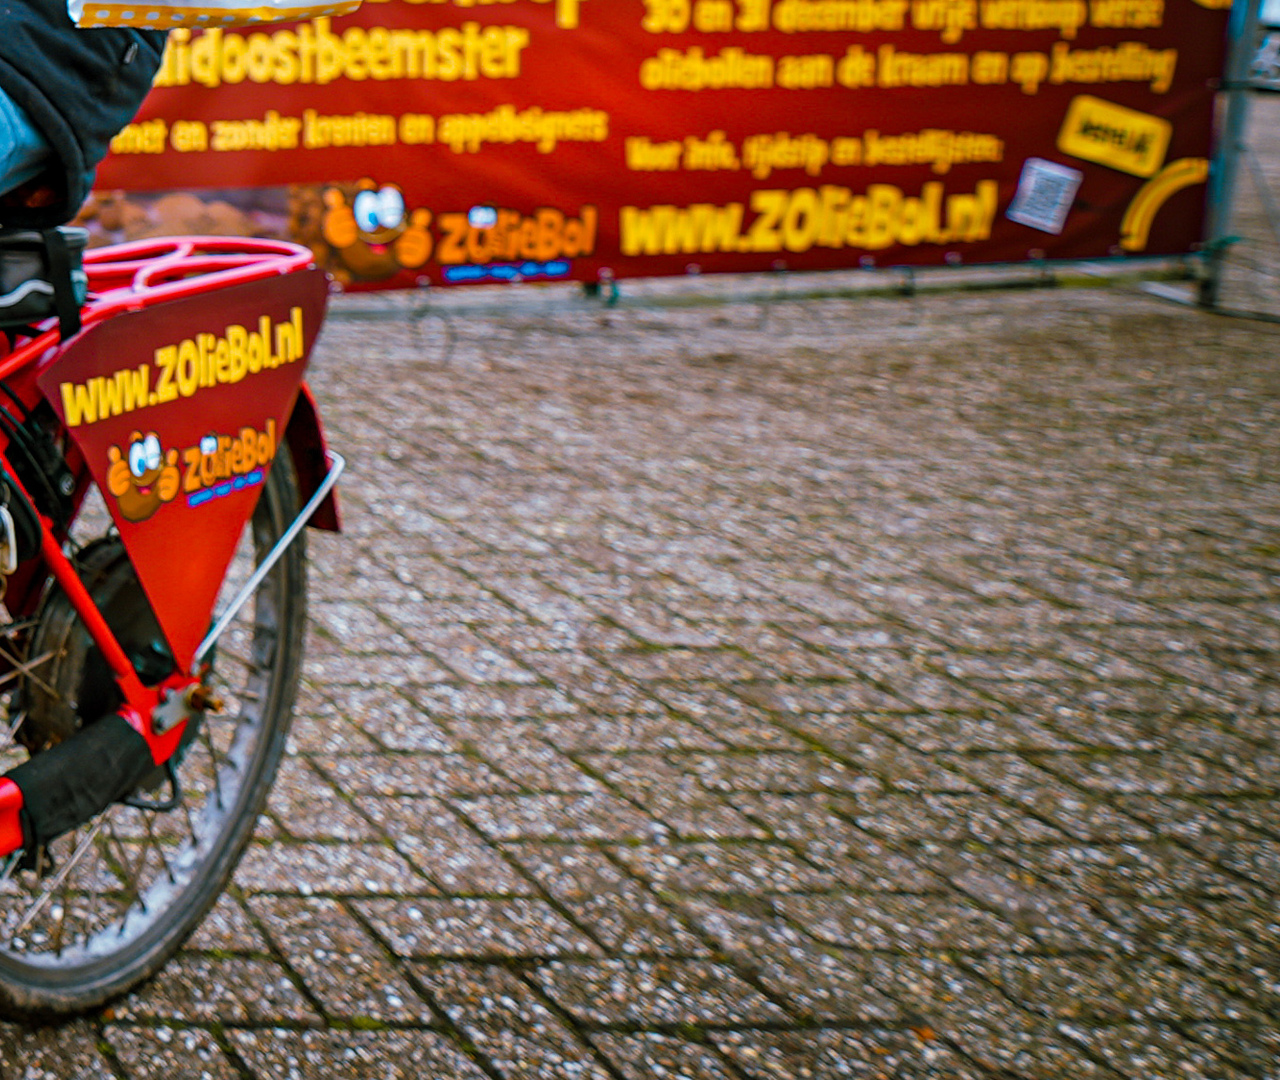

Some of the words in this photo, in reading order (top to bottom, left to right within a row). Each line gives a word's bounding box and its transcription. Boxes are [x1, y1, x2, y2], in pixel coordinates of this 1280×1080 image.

[640, 46, 774, 91] oliebollen
[776, 53, 835, 89] aan
[837, 44, 875, 89] de
[877, 44, 969, 89] kraam
[971, 50, 1009, 85] en
[1010, 51, 1049, 95] op
[1049, 41, 1178, 95] bestelling
[170, 120, 208, 152] en
[210, 109, 302, 151] zonder
[303, 108, 396, 150] krenten
[399, 113, 435, 144] en
[830, 135, 862, 167] en
[620, 180, 999, 256] www.ZOlieBol.nl
[60, 306, 303, 427] www.ZOlieBol.nl
